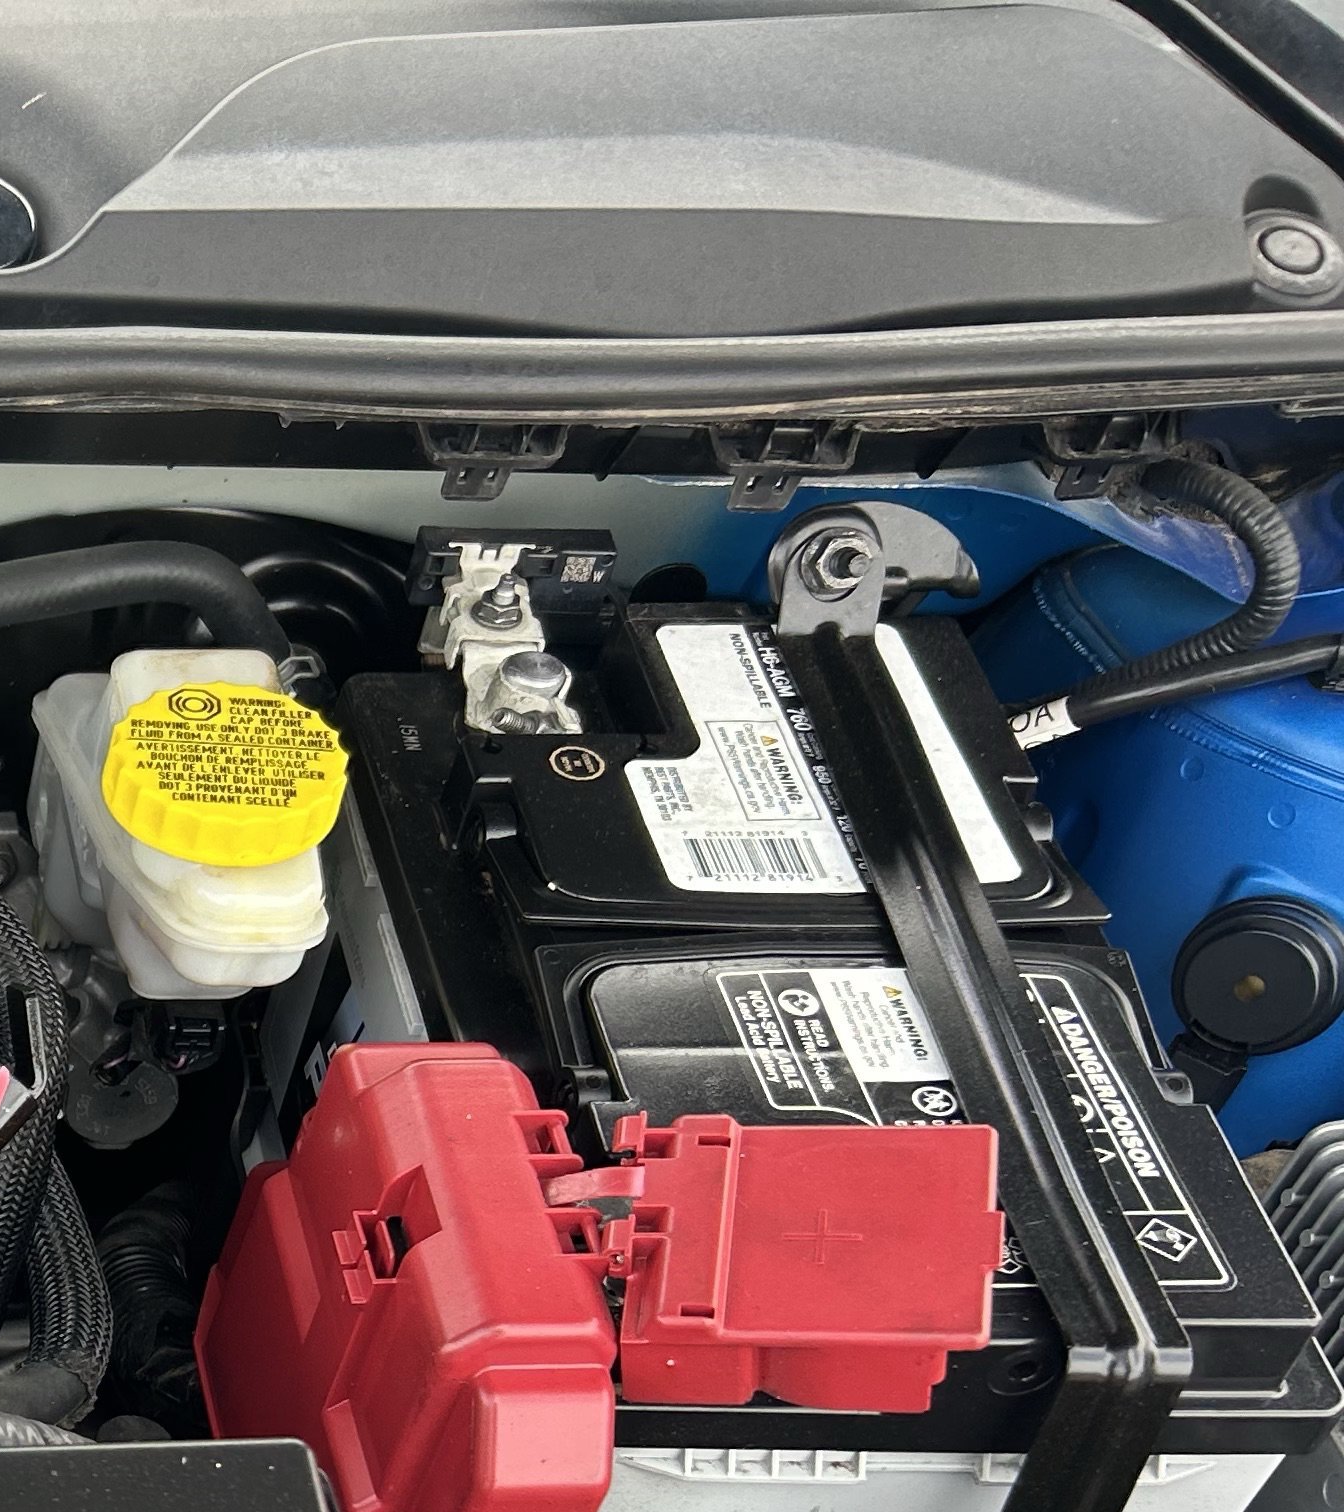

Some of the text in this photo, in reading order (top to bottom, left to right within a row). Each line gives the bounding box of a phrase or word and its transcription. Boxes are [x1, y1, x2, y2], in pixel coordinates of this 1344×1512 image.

[729, 633, 772, 709] NON-SPILLABLE
[758, 647, 797, 698] H6-AGM
[787, 707, 814, 732] 760
[229, 697, 285, 708] WARNING:
[229, 707, 312, 719] CLEAN FILLER
[230, 716, 303, 728] CAP BEFORE
[131, 729, 163, 738] FLUID
[169, 731, 201, 740] FROM
[206, 733, 214, 741] A
[218, 734, 264, 745] SEALED
[196, 723, 217, 732] USE
[221, 725, 250, 735] ONLY
[255, 727, 275, 736] DOT
[280, 728, 287, 736] 3
[291, 729, 330, 740] BRAKE
[151, 752, 308, 770] BOUCHON DE REMPLISSAGE
[242, 748, 301, 759] NETTOYER
[306, 752, 320, 761] LE
[136, 761, 177, 771] AVANT
[183, 763, 196, 772] DE
[272, 769, 325, 780] UTILISER
[158, 772, 296, 787] SEULEMENT DU LIQUIDE
[159, 781, 180, 790] DOT
[185, 783, 192, 791] 3
[196, 783, 265, 795] PROVENANT
[172, 792, 241, 804] CONTENANT
[714, 874, 759, 882] 21112
[768, 874, 813, 882] 81914
[734, 996, 782, 1083] Lead Acid Battery
[747, 991, 804, 1089] NON-SPILLABLE
[808, 1020, 829, 1047] READ
[1060, 1023, 1160, 1177] DANGER/POISON
